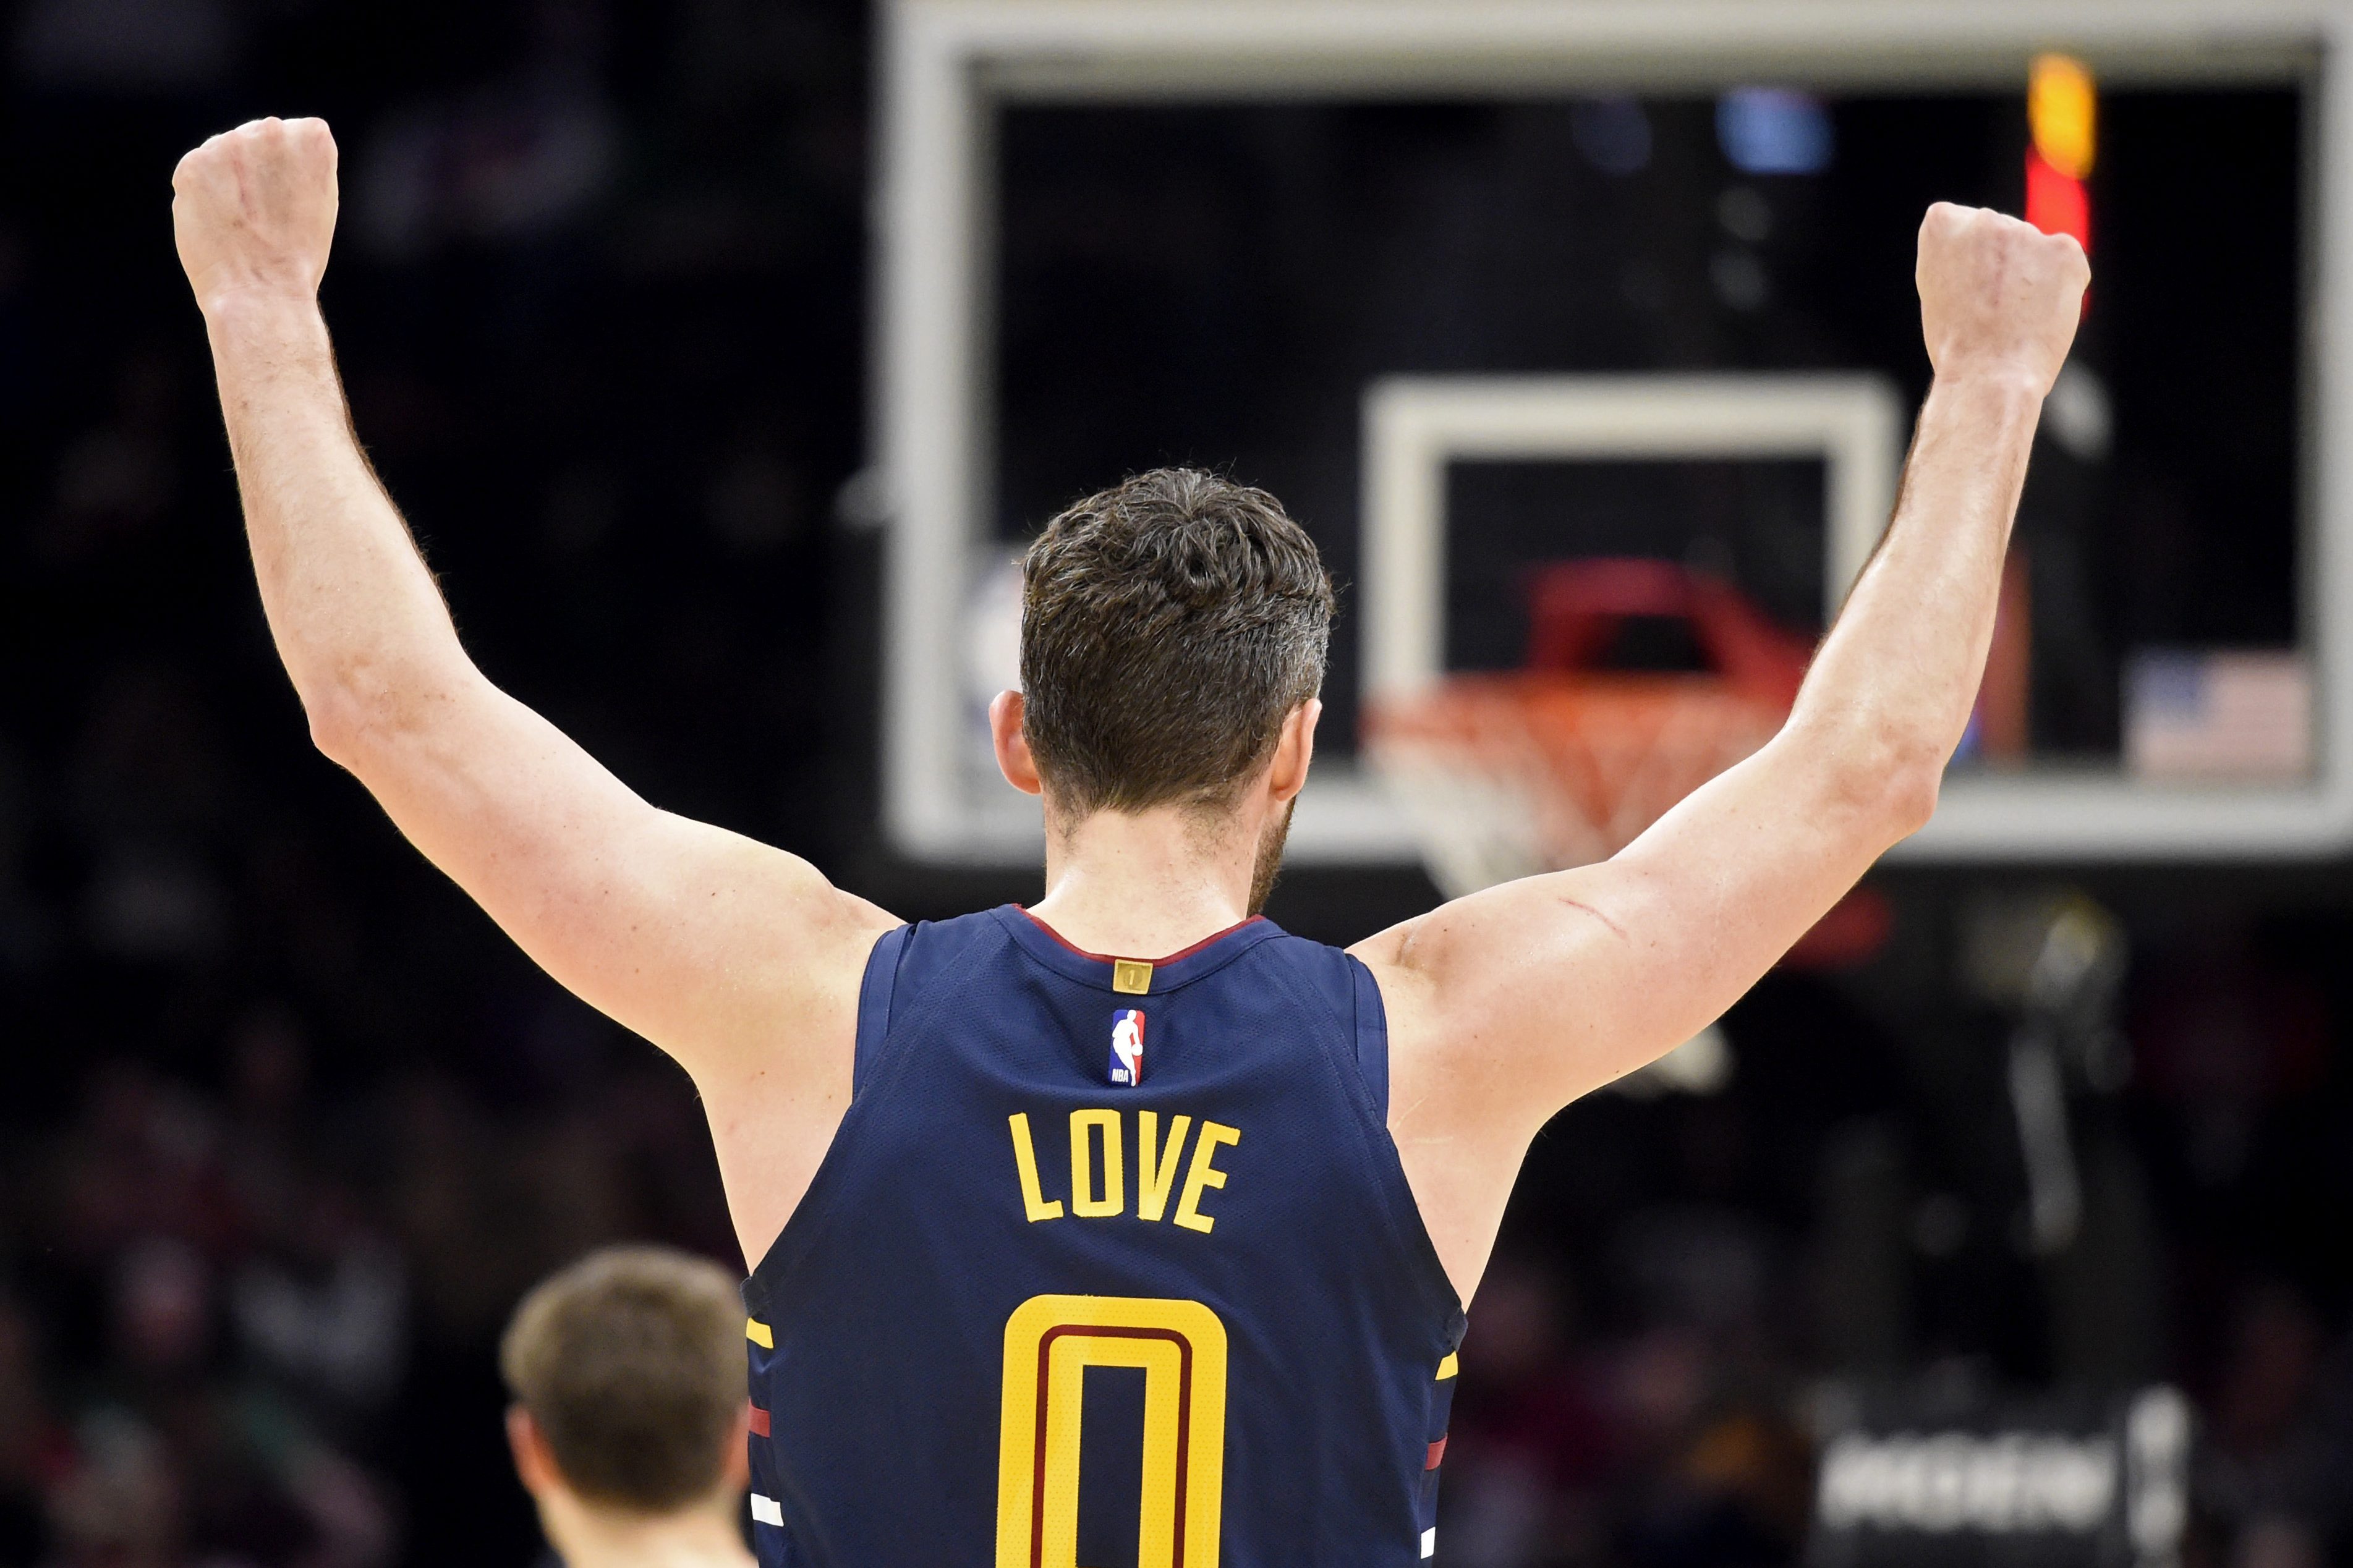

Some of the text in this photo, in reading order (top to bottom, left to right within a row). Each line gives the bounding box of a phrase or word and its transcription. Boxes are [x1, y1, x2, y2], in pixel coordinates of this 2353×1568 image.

[1112, 1068, 1129, 1083] NBA
[1008, 1109, 1241, 1234] LOVE
[995, 1294, 1228, 1568] 0
